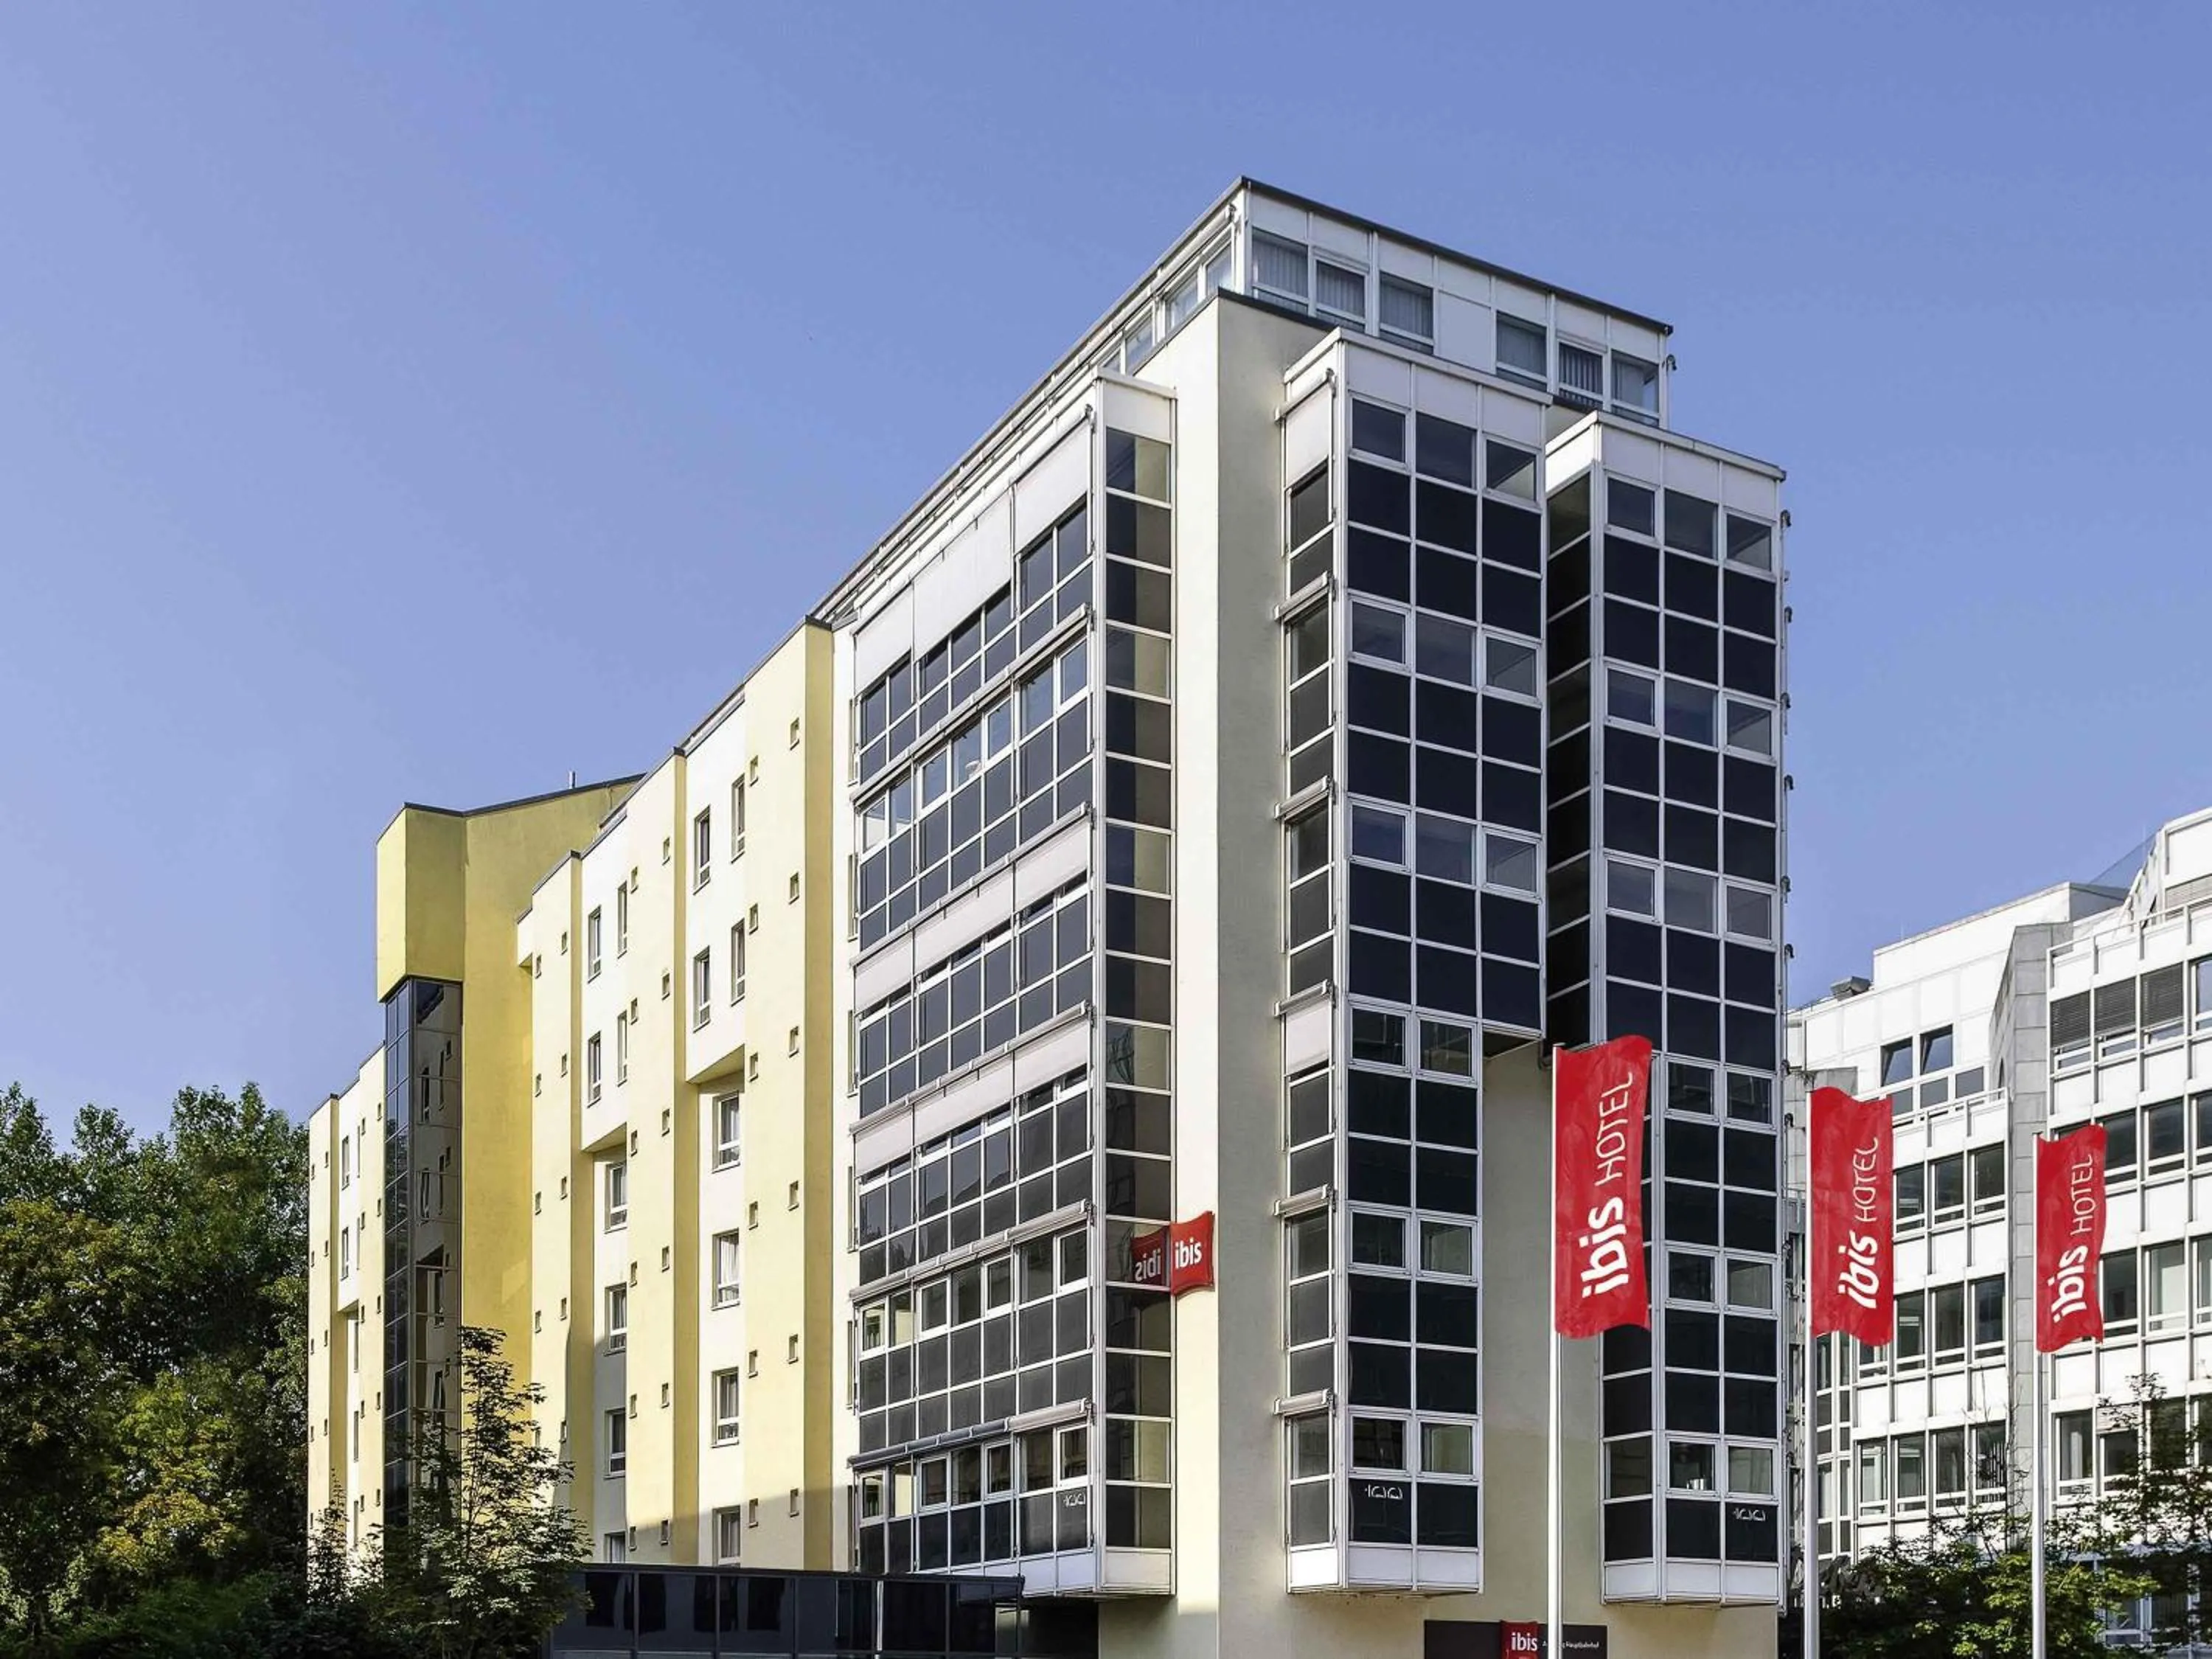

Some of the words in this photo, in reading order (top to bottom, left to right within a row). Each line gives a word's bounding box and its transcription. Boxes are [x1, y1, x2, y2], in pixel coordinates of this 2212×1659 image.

[1595, 1071, 1633, 1187] HOTEL
[1853, 1137, 1879, 1222] HOTEL
[1175, 1237, 1203, 1270] ibis
[1579, 1196, 1630, 1299] ibis
[1837, 1229, 1881, 1310] ibis
[2047, 1245, 2089, 1324] ibis
[2070, 1153, 2096, 1236] HOTEL
[1511, 1632, 1538, 1652] ibis
